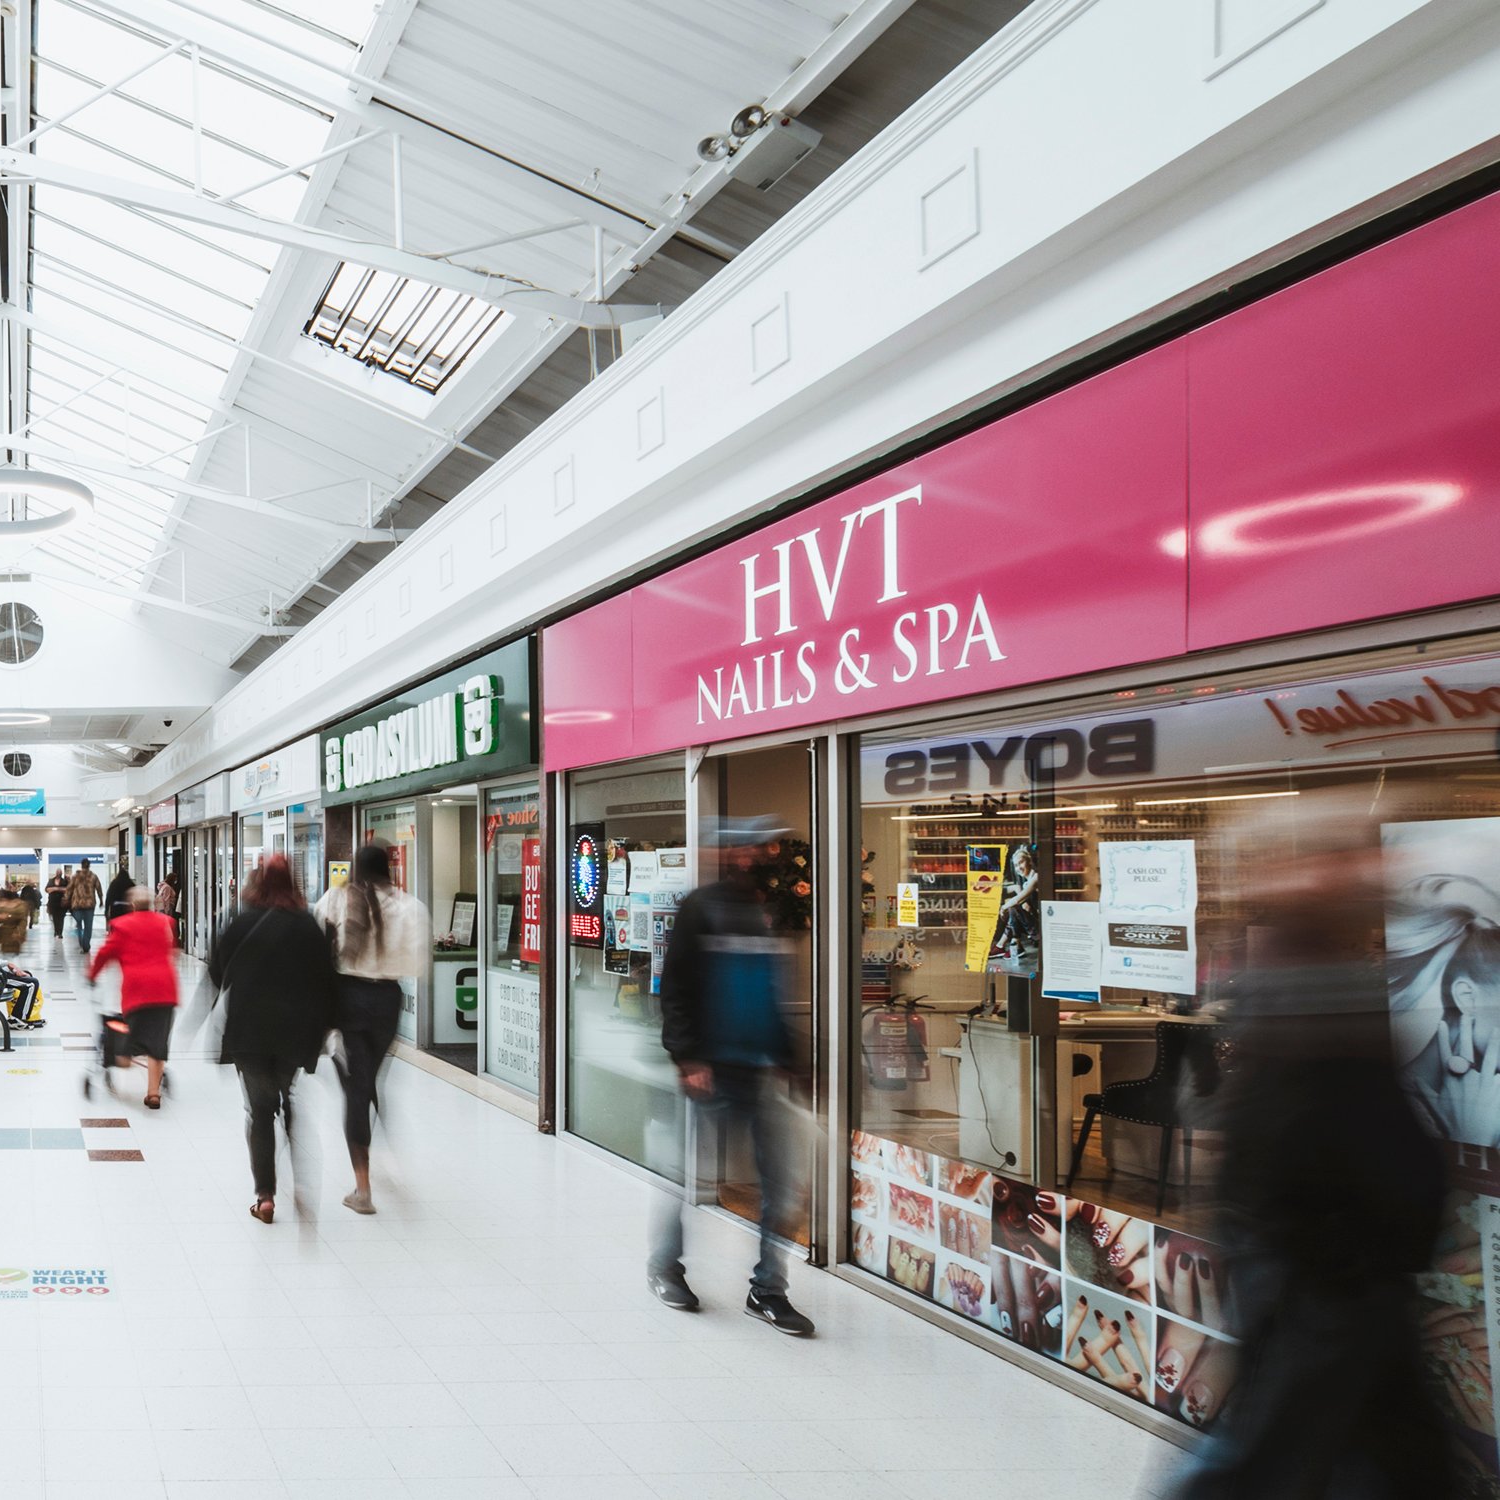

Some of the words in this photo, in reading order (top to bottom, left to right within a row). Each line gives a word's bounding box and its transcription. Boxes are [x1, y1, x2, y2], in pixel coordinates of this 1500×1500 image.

[739, 484, 922, 647] HVT
[696, 640, 817, 725] NAILS
[834, 628, 877, 695] &
[892, 593, 1008, 685] SPA
[343, 725, 377, 789] CBD
[376, 691, 458, 781] ASYLUM
[1127, 867, 1145, 875] CASH
[1124, 932, 1170, 940] ONLY
[32, 1276, 108, 1285] RIGHT
